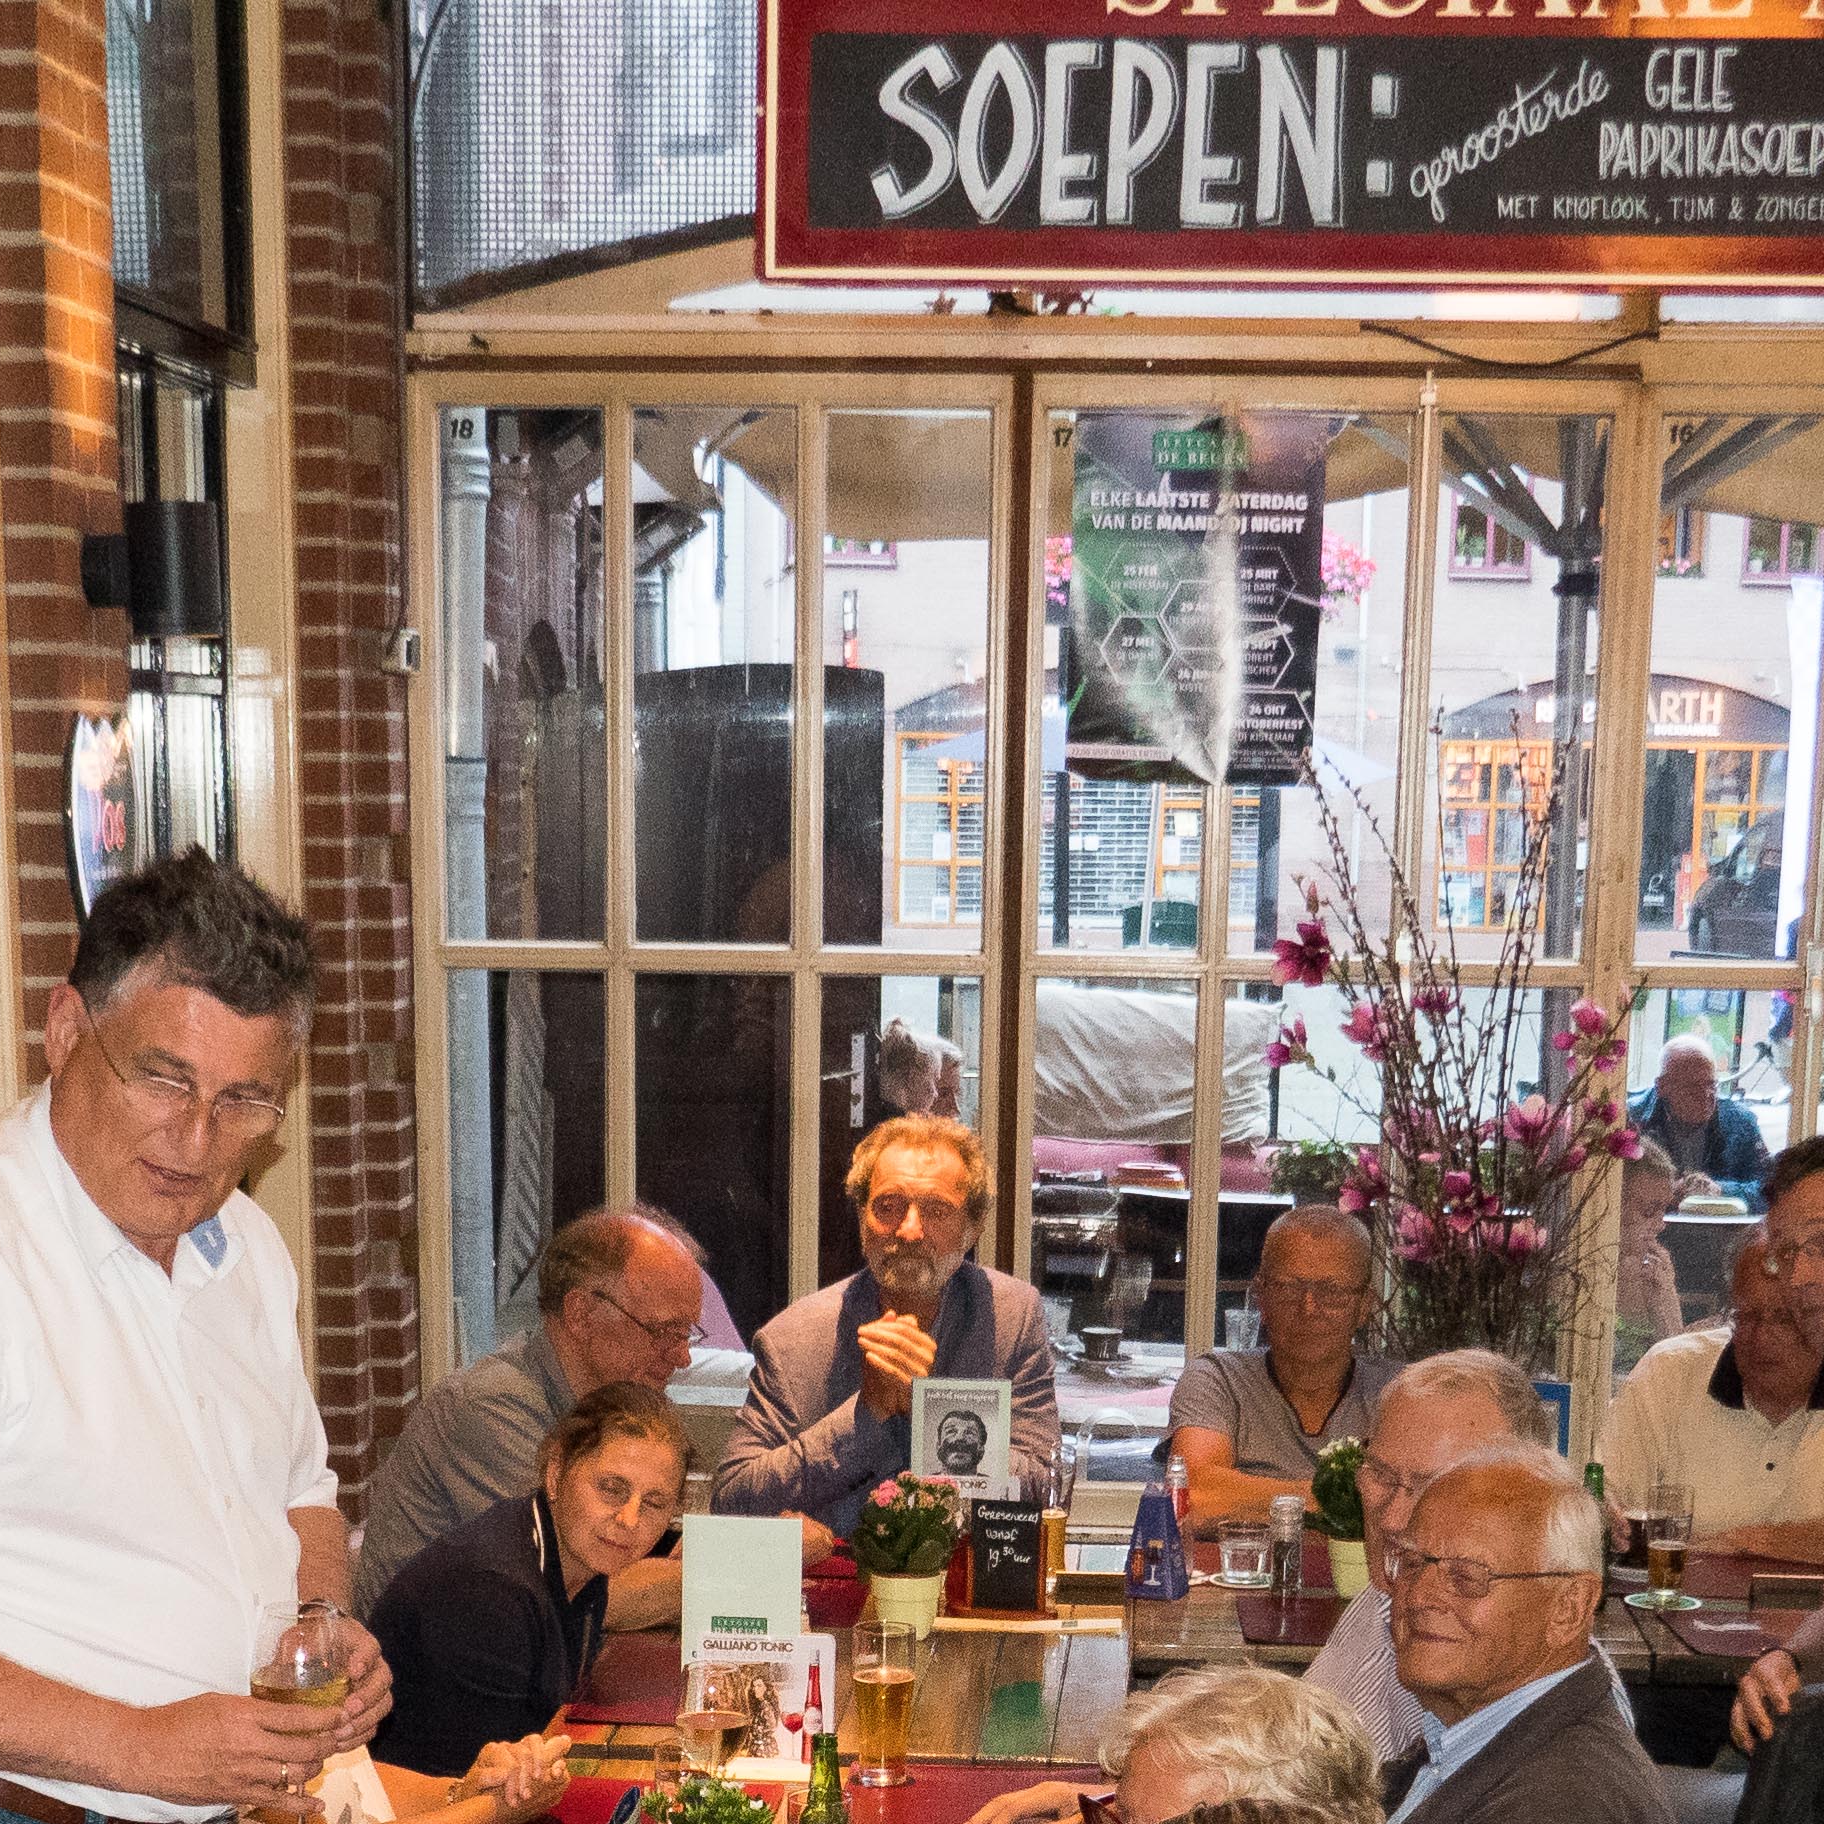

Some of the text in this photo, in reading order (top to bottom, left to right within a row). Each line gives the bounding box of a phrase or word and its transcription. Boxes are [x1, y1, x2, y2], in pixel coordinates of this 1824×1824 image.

[1645, 46, 1739, 113] GELE
[1410, 60, 1610, 221] geroosterde
[1495, 195, 1537, 221] MET
[1729, 195, 1744, 221] &
[449, 418, 475, 442] 18
[1052, 427, 1074, 448] 17
[1669, 423, 1694, 446] 16
[1090, 491, 1131, 507] ELKE
[1135, 491, 1211, 509] LAATSTE
[1092, 514, 1125, 530] VAN
[1132, 515, 1153, 531] DE
[1251, 516, 1306, 535] NIGHT
[702, 1639, 794, 1653] GALLIANO TONIC
